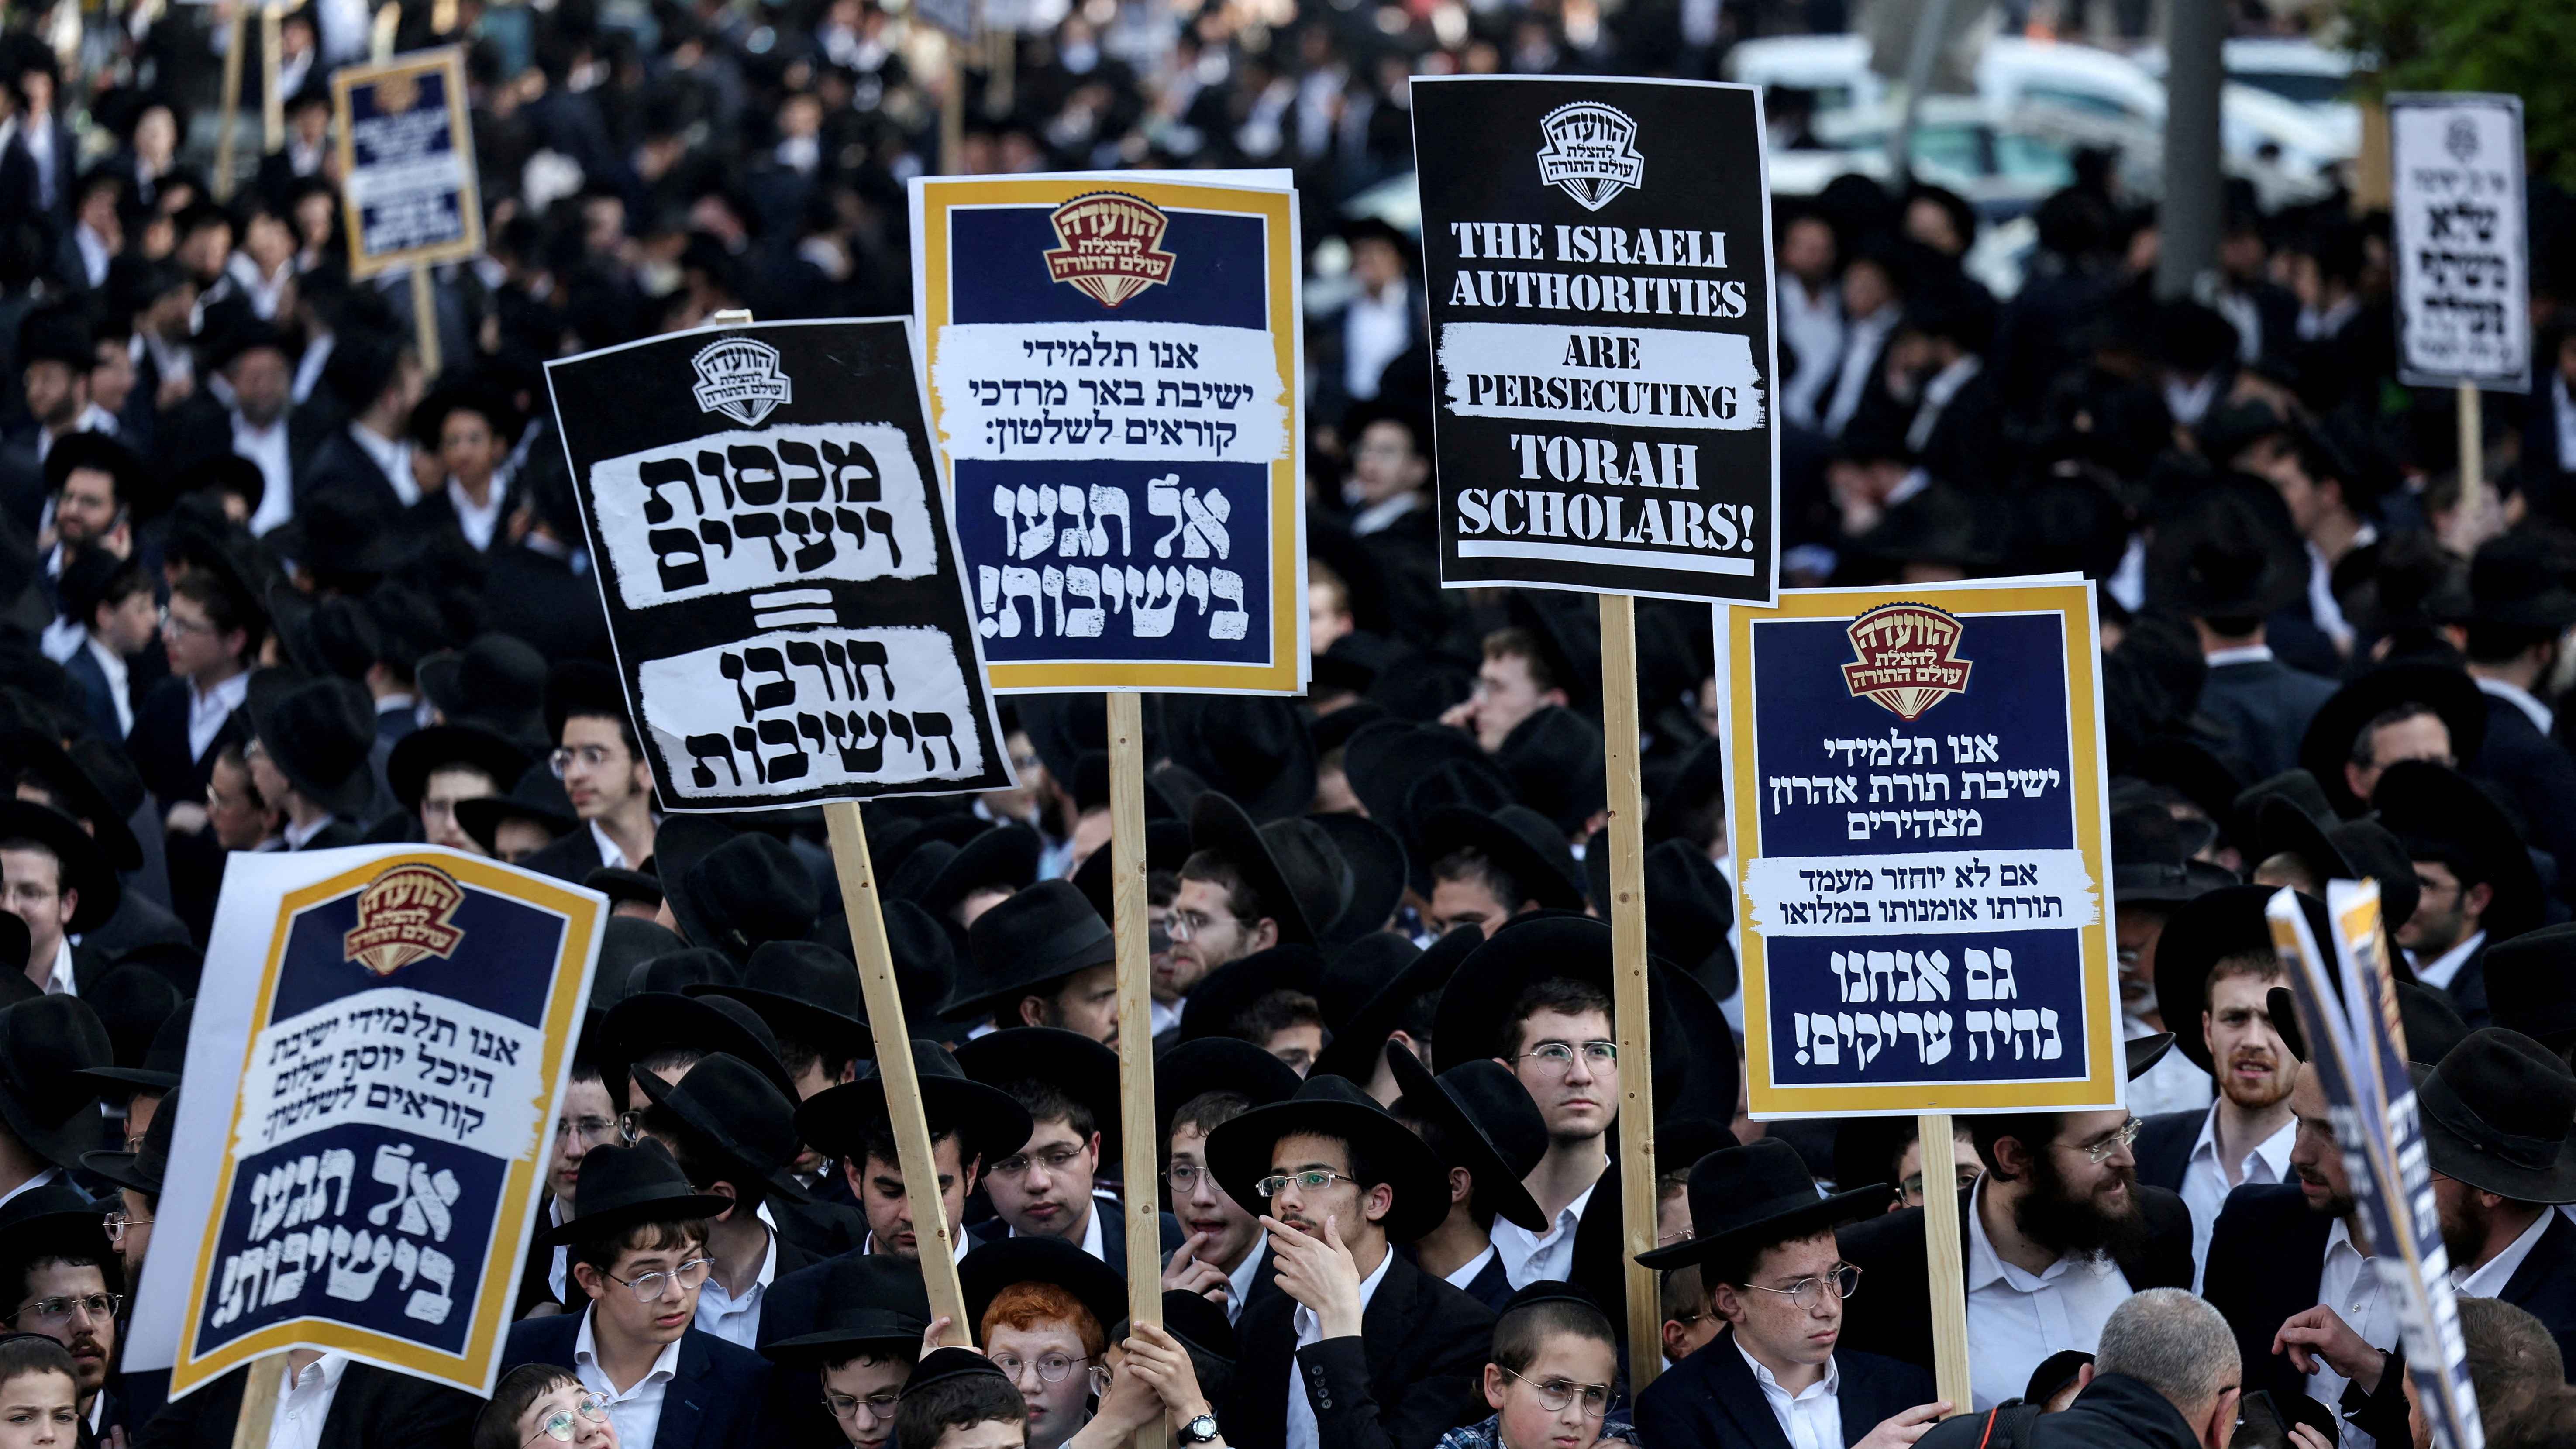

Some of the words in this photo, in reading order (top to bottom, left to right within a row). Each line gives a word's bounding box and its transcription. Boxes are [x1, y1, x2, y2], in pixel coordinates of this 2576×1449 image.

[1552, 112, 1627, 143] הוועדה
[1548, 160, 1594, 175] התורה
[1567, 144, 1616, 158] להצלת
[1599, 161, 1633, 177] עולם
[1062, 203, 1158, 238] הוועדה
[1078, 238, 1142, 256] להצלת
[1451, 223, 1543, 260] THE
[1555, 225, 1727, 268] ISRAELI
[1054, 255, 1115, 274] התורה
[1119, 256, 1166, 277] עולם
[1449, 271, 1746, 318] AUTHORITIES
[703, 347, 770, 374] הוועדה
[1023, 330, 1137, 367] תלמידי
[1150, 341, 1198, 369] אנו
[1562, 335, 1640, 369] ARE
[704, 385, 747, 403] התורה
[720, 370, 762, 385] להצלת
[750, 383, 782, 396] עולם
[969, 379, 1067, 406] מרדכי
[1079, 379, 1145, 406] באר
[1156, 380, 1253, 409] ישיבת
[1467, 374, 1736, 419] PERSECUTING
[987, 408, 1112, 454] לשלטון:
[1126, 418, 1236, 457] קוראים
[1511, 434, 1699, 490] TORAH
[639, 439, 881, 525] מכסות
[994, 484, 1131, 560] תגעו
[1148, 474, 1230, 559] אל
[1458, 489, 1753, 552] SCHOLARS!
[649, 506, 902, 592] ויעדים
[978, 564, 1249, 640] בישיבות!
[1857, 613, 1953, 650] הוועדה
[1875, 648, 1937, 666] להצלת
[1916, 664, 1962, 685] עולם
[720, 639, 895, 723] חורבן
[1852, 668, 1910, 688] התורה
[685, 709, 960, 788] הישיבות
[1824, 727, 1937, 767] תלמידי
[1948, 733, 1999, 763] אנו
[1770, 775, 1858, 814] אהרון
[1869, 772, 1949, 802] תורת
[1961, 768, 2059, 799] ישיבת
[1848, 808, 1982, 839] מצהירים
[1800, 868, 1873, 894] מעמד
[1881, 866, 1945, 890] יוחזר
[1955, 857, 1990, 888] לא
[2000, 863, 2038, 886] אם
[1780, 894, 1871, 924] במלואו
[1879, 898, 1977, 922] אומנותו
[1987, 895, 2062, 919] תורתו
[1831, 950, 1950, 1002] אנחנו
[1965, 947, 2017, 1000] גם
[269, 1016, 339, 1065] ישיבת
[349, 1002, 457, 1046] תלמידי
[1794, 1010, 1952, 1070] עריקים!
[1966, 1007, 2062, 1061] נהיה
[341, 1045, 404, 1080] יוסף
[469, 1027, 520, 1066] אנו
[273, 1053, 333, 1097] שלום
[417, 1043, 493, 1098] היכל
[365, 1082, 485, 1139] קוראים
[248, 1149, 355, 1241] תגעו
[368, 1143, 460, 1242] אל
[212, 1225, 454, 1328] בישיבות!
